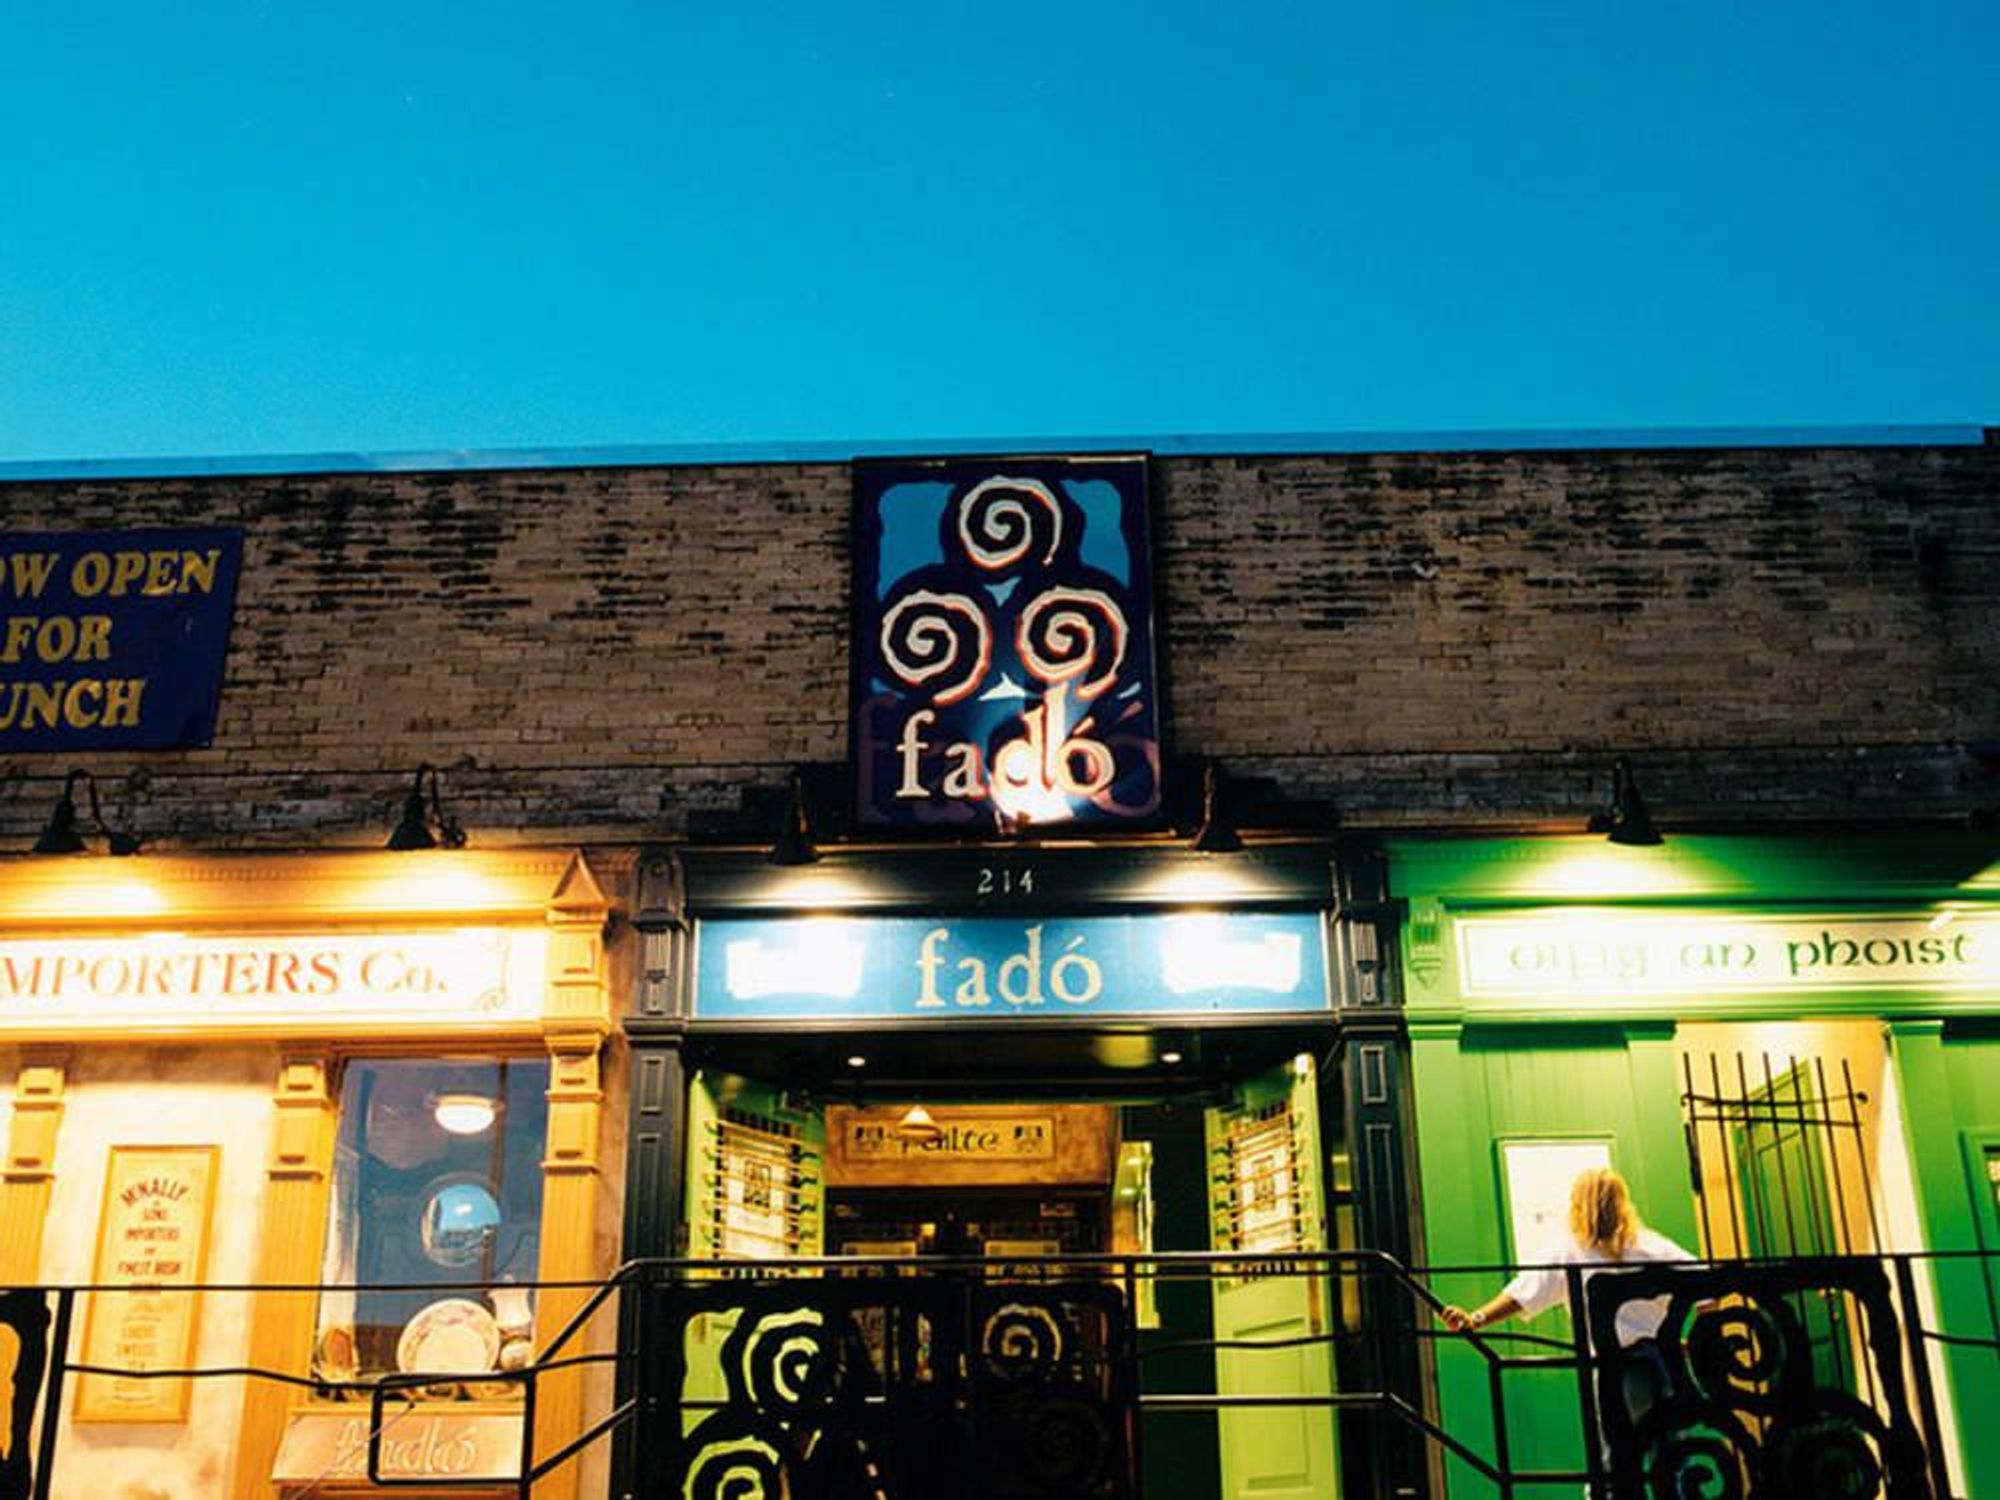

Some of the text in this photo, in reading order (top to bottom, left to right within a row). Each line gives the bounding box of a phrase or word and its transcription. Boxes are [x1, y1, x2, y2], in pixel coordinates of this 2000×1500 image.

[0, 549, 221, 598] W OPEN
[2, 615, 113, 663] FOR
[977, 867, 1032, 894] 214
[915, 925, 1102, 1008] fadó
